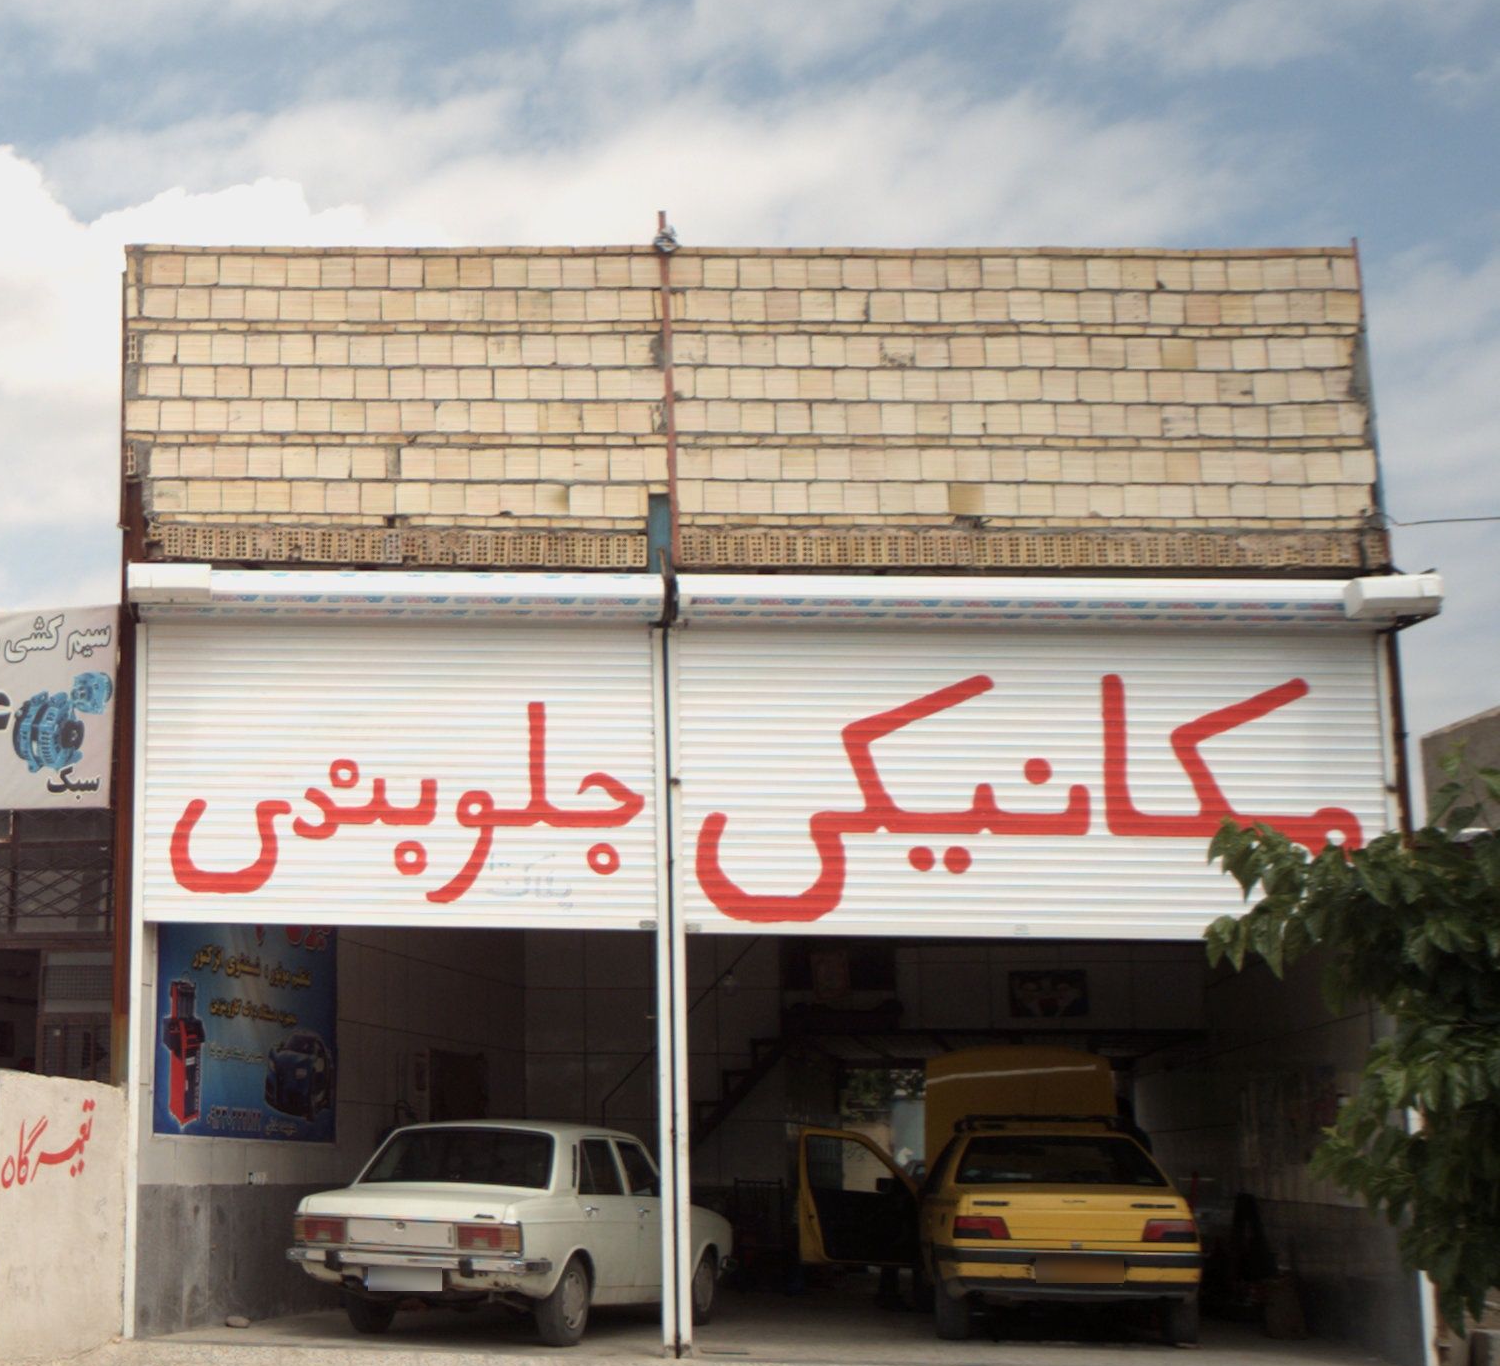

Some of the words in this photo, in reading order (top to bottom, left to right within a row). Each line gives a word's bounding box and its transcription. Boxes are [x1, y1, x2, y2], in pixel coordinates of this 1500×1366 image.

[66, 625, 112, 661] سیم
[47, 766, 101, 800] سبک
[169, 701, 646, 905] جلوبندی
[694, 673, 1364, 925] مکانیکی
[0, 1098, 98, 1190] تعمیرگاه
